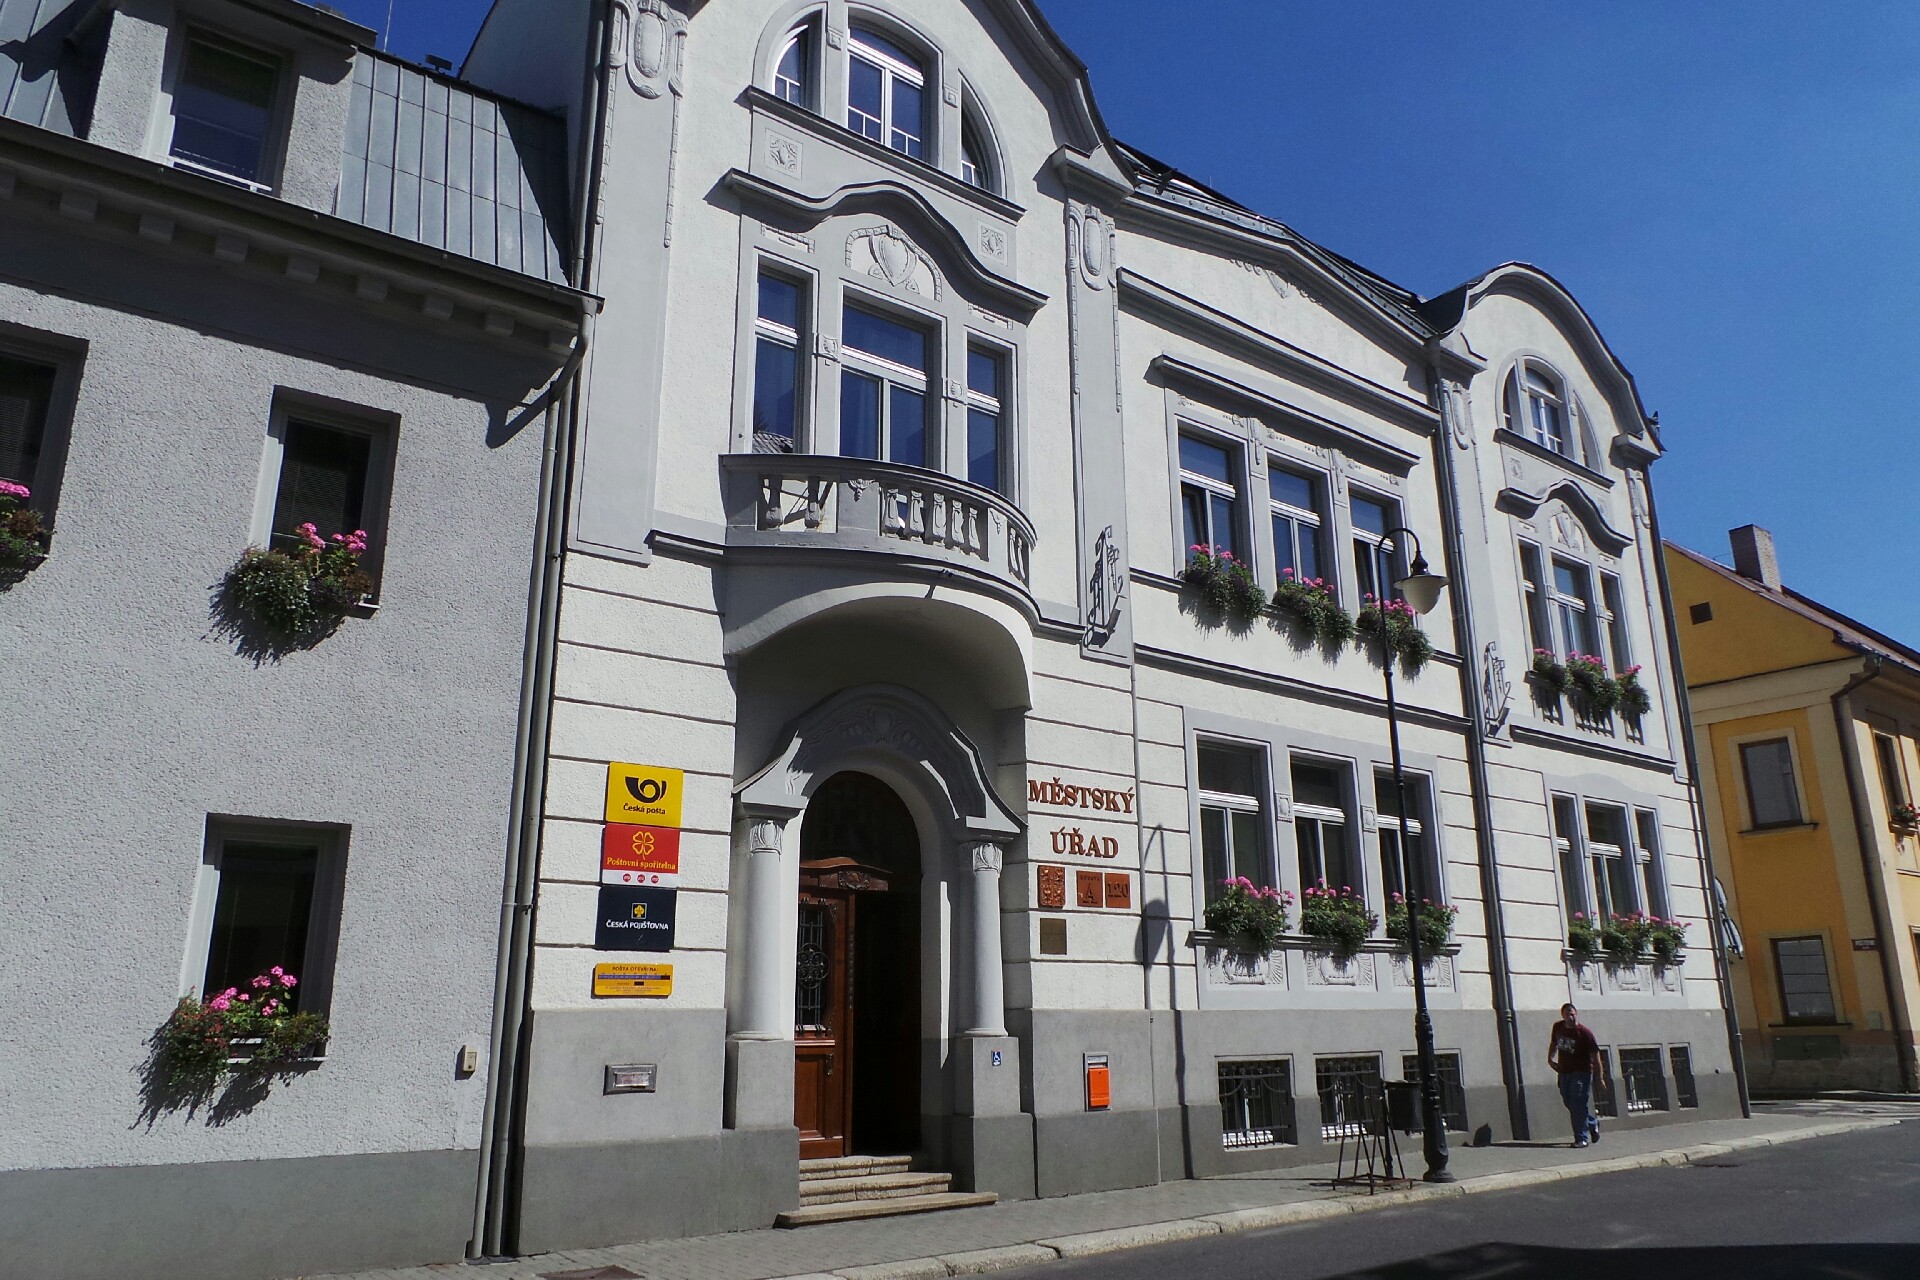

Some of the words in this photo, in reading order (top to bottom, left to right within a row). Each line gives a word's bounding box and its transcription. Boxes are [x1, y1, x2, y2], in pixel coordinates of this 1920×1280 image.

[1028, 777, 1135, 813] MĚSTSKÝ
[623, 803, 645, 812] Česká
[646, 806, 666, 815] pošta
[1050, 826, 1119, 858] ÚŘAD
[606, 857, 639, 867] Poštovní
[640, 859, 676, 870] spořitelna
[1107, 882, 1129, 898] 120
[606, 919, 629, 929] ČESKÁ
